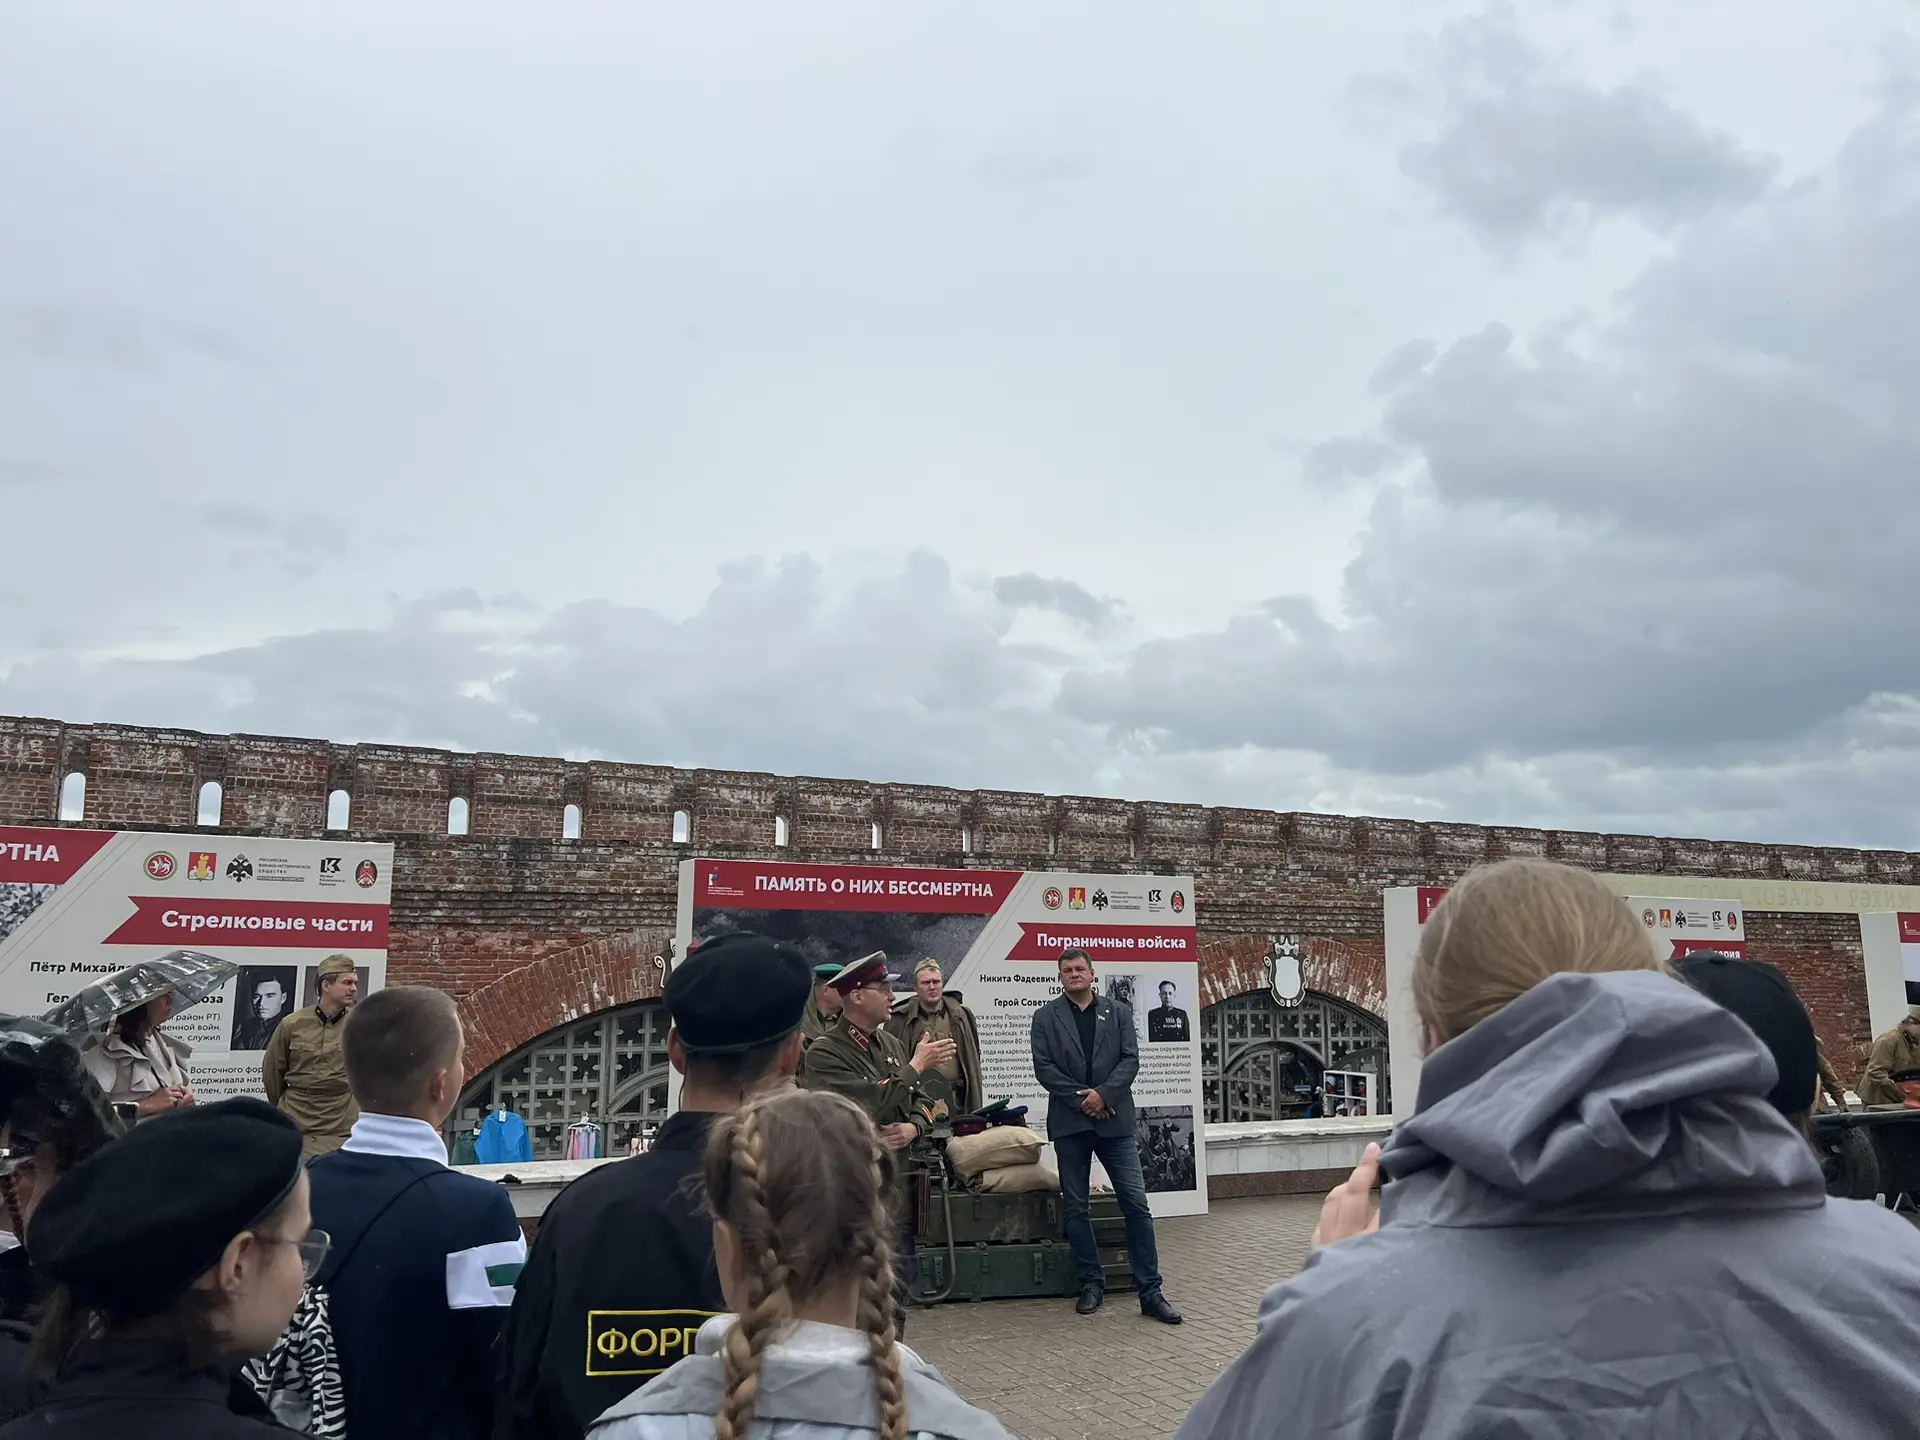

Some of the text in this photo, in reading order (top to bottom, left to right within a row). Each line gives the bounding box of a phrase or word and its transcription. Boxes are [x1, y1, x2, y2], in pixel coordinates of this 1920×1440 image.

[755, 875, 827, 892] ПАМЯТЬ
[831, 878, 845, 893] О
[849, 879, 884, 894] НИХ
[888, 880, 994, 897] БЕССМЕРТНА
[161, 910, 373, 932] Стрелковые части
[1037, 933, 1187, 949] Пограничные войска
[30, 961, 66, 975] Пётр
[980, 974, 1012, 983] Никита
[1013, 974, 1056, 984] Фадеевич
[198, 995, 224, 1004] оза
[994, 998, 1019, 1008] Герой
[176, 1013, 204, 1021] район
[187, 1034, 221, 1042] служил
[190, 1066, 243, 1074] Восточного
[190, 1077, 245, 1085] сдерживала
[224, 1087, 238, 1095] где
